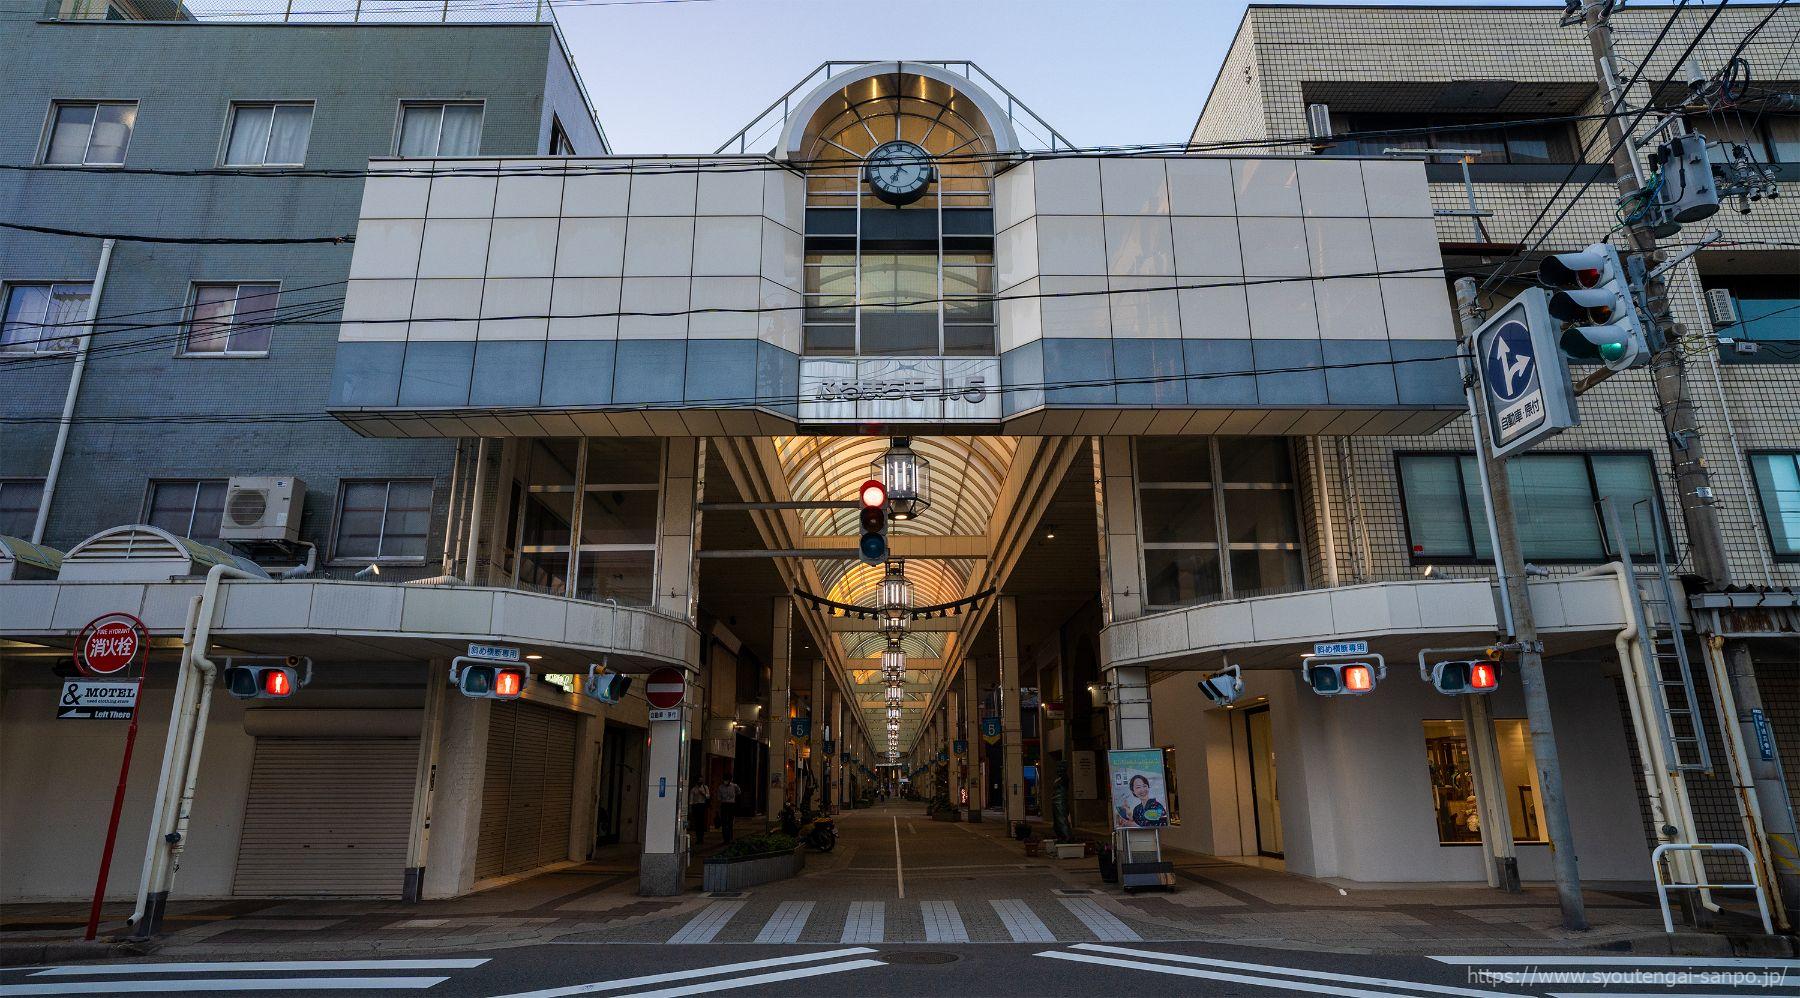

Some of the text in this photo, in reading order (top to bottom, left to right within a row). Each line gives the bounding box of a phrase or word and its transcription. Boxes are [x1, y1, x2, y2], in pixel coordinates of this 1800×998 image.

[108, 627, 130, 635] HYDRANT
[90, 636, 134, 658] 消火栓
[62, 683, 135, 705] & MOTEL
[109, 710, 131, 719] There
[796, 724, 804, 736] 5
[988, 723, 996, 736] 5
